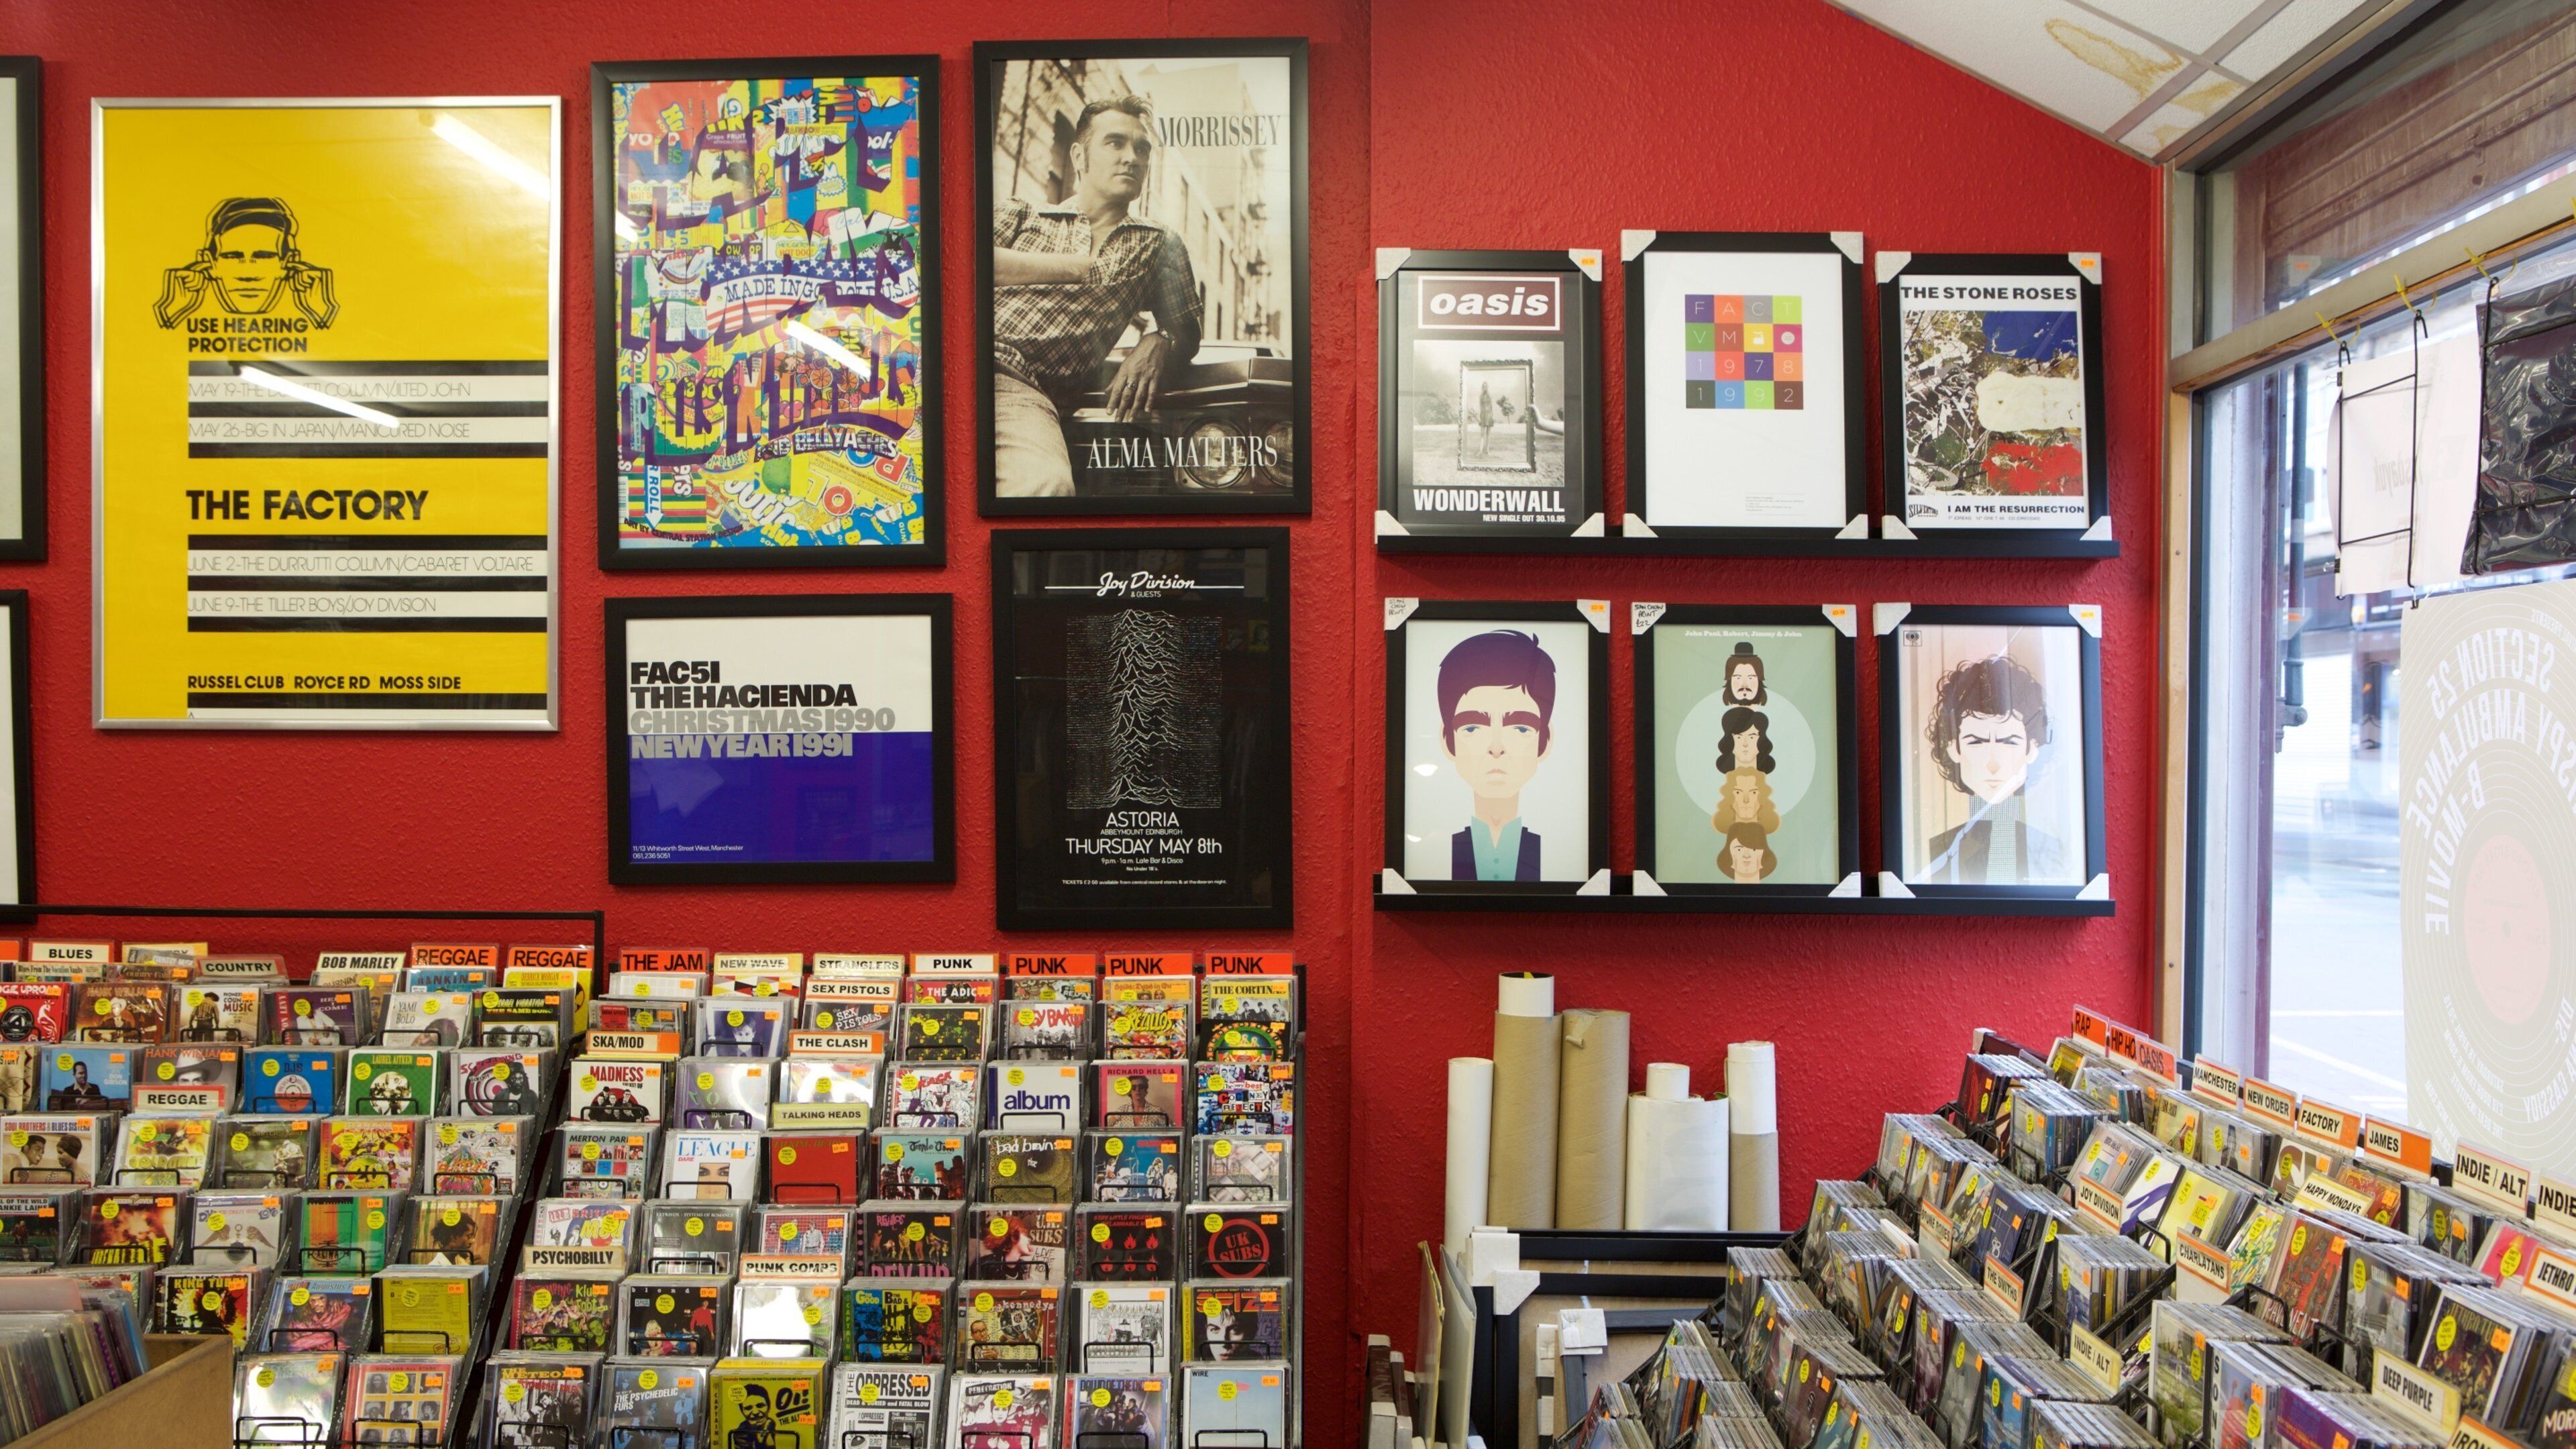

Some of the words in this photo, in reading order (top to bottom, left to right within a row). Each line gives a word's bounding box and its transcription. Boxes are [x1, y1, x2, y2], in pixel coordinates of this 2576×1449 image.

[1158, 115, 1280, 148] MORRISSEY
[724, 278, 775, 303] MADE
[780, 279, 794, 296] IN
[1900, 286, 1939, 299] THE
[1943, 287, 2008, 299] STONE
[2012, 288, 2077, 299] ROSES
[1430, 286, 1549, 317] oasis
[187, 317, 218, 333] USE
[223, 317, 309, 333] HEARING
[188, 337, 308, 353] PROTECTION
[189, 382, 221, 397] MAY
[431, 382, 471, 397] JOHN
[189, 423, 221, 438] MAY
[223, 423, 268, 438] 26-BIG
[273, 423, 286, 438] IN
[429, 423, 470, 438] NOISE
[1087, 437, 1155, 468] ALMA
[1163, 435, 1277, 468] MATTERS
[186, 490, 250, 520] THE
[264, 490, 429, 521] FACTORY
[1413, 488, 1565, 513] WONDERWALL
[1483, 514, 1498, 522] NEW
[1499, 514, 1521, 522] SINGLE
[1521, 514, 1534, 522] OUT
[187, 556, 221, 572] JUNE
[226, 556, 264, 572] 2-THE
[268, 556, 332, 572] DURRUTTI
[474, 556, 533, 572] VOLTAIRE
[1096, 571, 1129, 597] Joy
[1130, 570, 1195, 590] Division
[187, 597, 221, 612] JUNE
[225, 597, 263, 612] 9-THE
[268, 597, 305, 612] TILLER
[378, 597, 436, 612] DIVISION
[188, 676, 241, 689] RUSSEL
[244, 676, 284, 689] CLUB
[294, 676, 345, 689] ROYCE
[349, 676, 371, 689] RD
[379, 676, 424, 689] MOSS
[427, 676, 462, 689] SIDE
[631, 686, 692, 709] THE
[693, 684, 857, 708] HACIENDA
[630, 708, 823, 734] CHRISTMAS
[824, 707, 896, 732] 1990
[1106, 811, 1179, 828] ASTORIA
[1065, 839, 1154, 855] THURSDAY
[1159, 839, 1194, 855] MAY
[1197, 838, 1222, 855] 8th
[48, 949, 93, 959] BLUES
[321, 957, 347, 968] BOB
[350, 956, 398, 969] MARLEY
[417, 949, 490, 966] REGGAE
[514, 950, 588, 968] REGGAE
[623, 953, 659, 971] THE
[663, 953, 703, 971] JAM
[205, 962, 272, 973] COUNTRY
[720, 958, 748, 969] NEW
[751, 958, 786, 969] WAVE
[819, 959, 900, 971] STRANGLERS
[932, 957, 973, 969] PUNK
[1016, 957, 1067, 974] PUNK
[1110, 957, 1164, 975] PUNK
[1211, 956, 1263, 973] PUNK
[812, 984, 833, 994] SEX
[836, 985, 891, 996] PISTOLS
[223, 1002, 253, 1013] MUSIC
[2075, 1012, 2092, 1036] RAP
[592, 1036, 644, 1049] SKA/MOD
[797, 1037, 818, 1047] THE
[820, 1037, 868, 1048] CLASH
[2111, 1028, 2124, 1051] HIP
[2124, 1034, 2137, 1061] HO
[146, 1048, 177, 1058] HANK
[2139, 1044, 2164, 1075] OASIS
[590, 1065, 644, 1083] MADNESS
[2194, 1067, 2237, 1095] MANCHESTER
[1245, 1081, 1263, 1089] best
[148, 1093, 207, 1106] REGGAE
[1004, 1090, 1071, 1110] album
[2247, 1089, 2263, 1106] NEW
[2265, 1096, 2290, 1116] ORDER
[782, 1111, 826, 1120] TALKING
[828, 1111, 861, 1119] HEADS
[2301, 1110, 2341, 1134] FACTORY
[2369, 1131, 2400, 1152] JAMES
[2455, 1153, 2490, 1185] INDIE
[2500, 1173, 2526, 1198] ALT
[2080, 1187, 2092, 1201] JOY
[2093, 1194, 2120, 1220] DIVISION
[2304, 1183, 2326, 1201] HAPPY
[2326, 1194, 2362, 1216] MONDAYS
[1224, 1231, 1250, 1249] UK
[533, 1250, 614, 1265] PSYCHOBILLY
[2180, 1244, 2225, 1280] CHARLATANS
[746, 1263, 784, 1273] PUNK
[793, 1263, 838, 1273] COMPS
[2537, 1260, 2573, 1293] JETHRO
[1987, 1266, 1998, 1281] THE
[1999, 1272, 2018, 1303] SMITHS
[2074, 1334, 2092, 1359] INDIE
[2096, 1352, 2110, 1374] ALT
[631, 1388, 678, 1401] PSYCHEDELIC
[2383, 1364, 2402, 1391] DEEP
[2402, 1374, 2433, 1413] PURPLE
[614, 1401, 634, 1411] FURS
